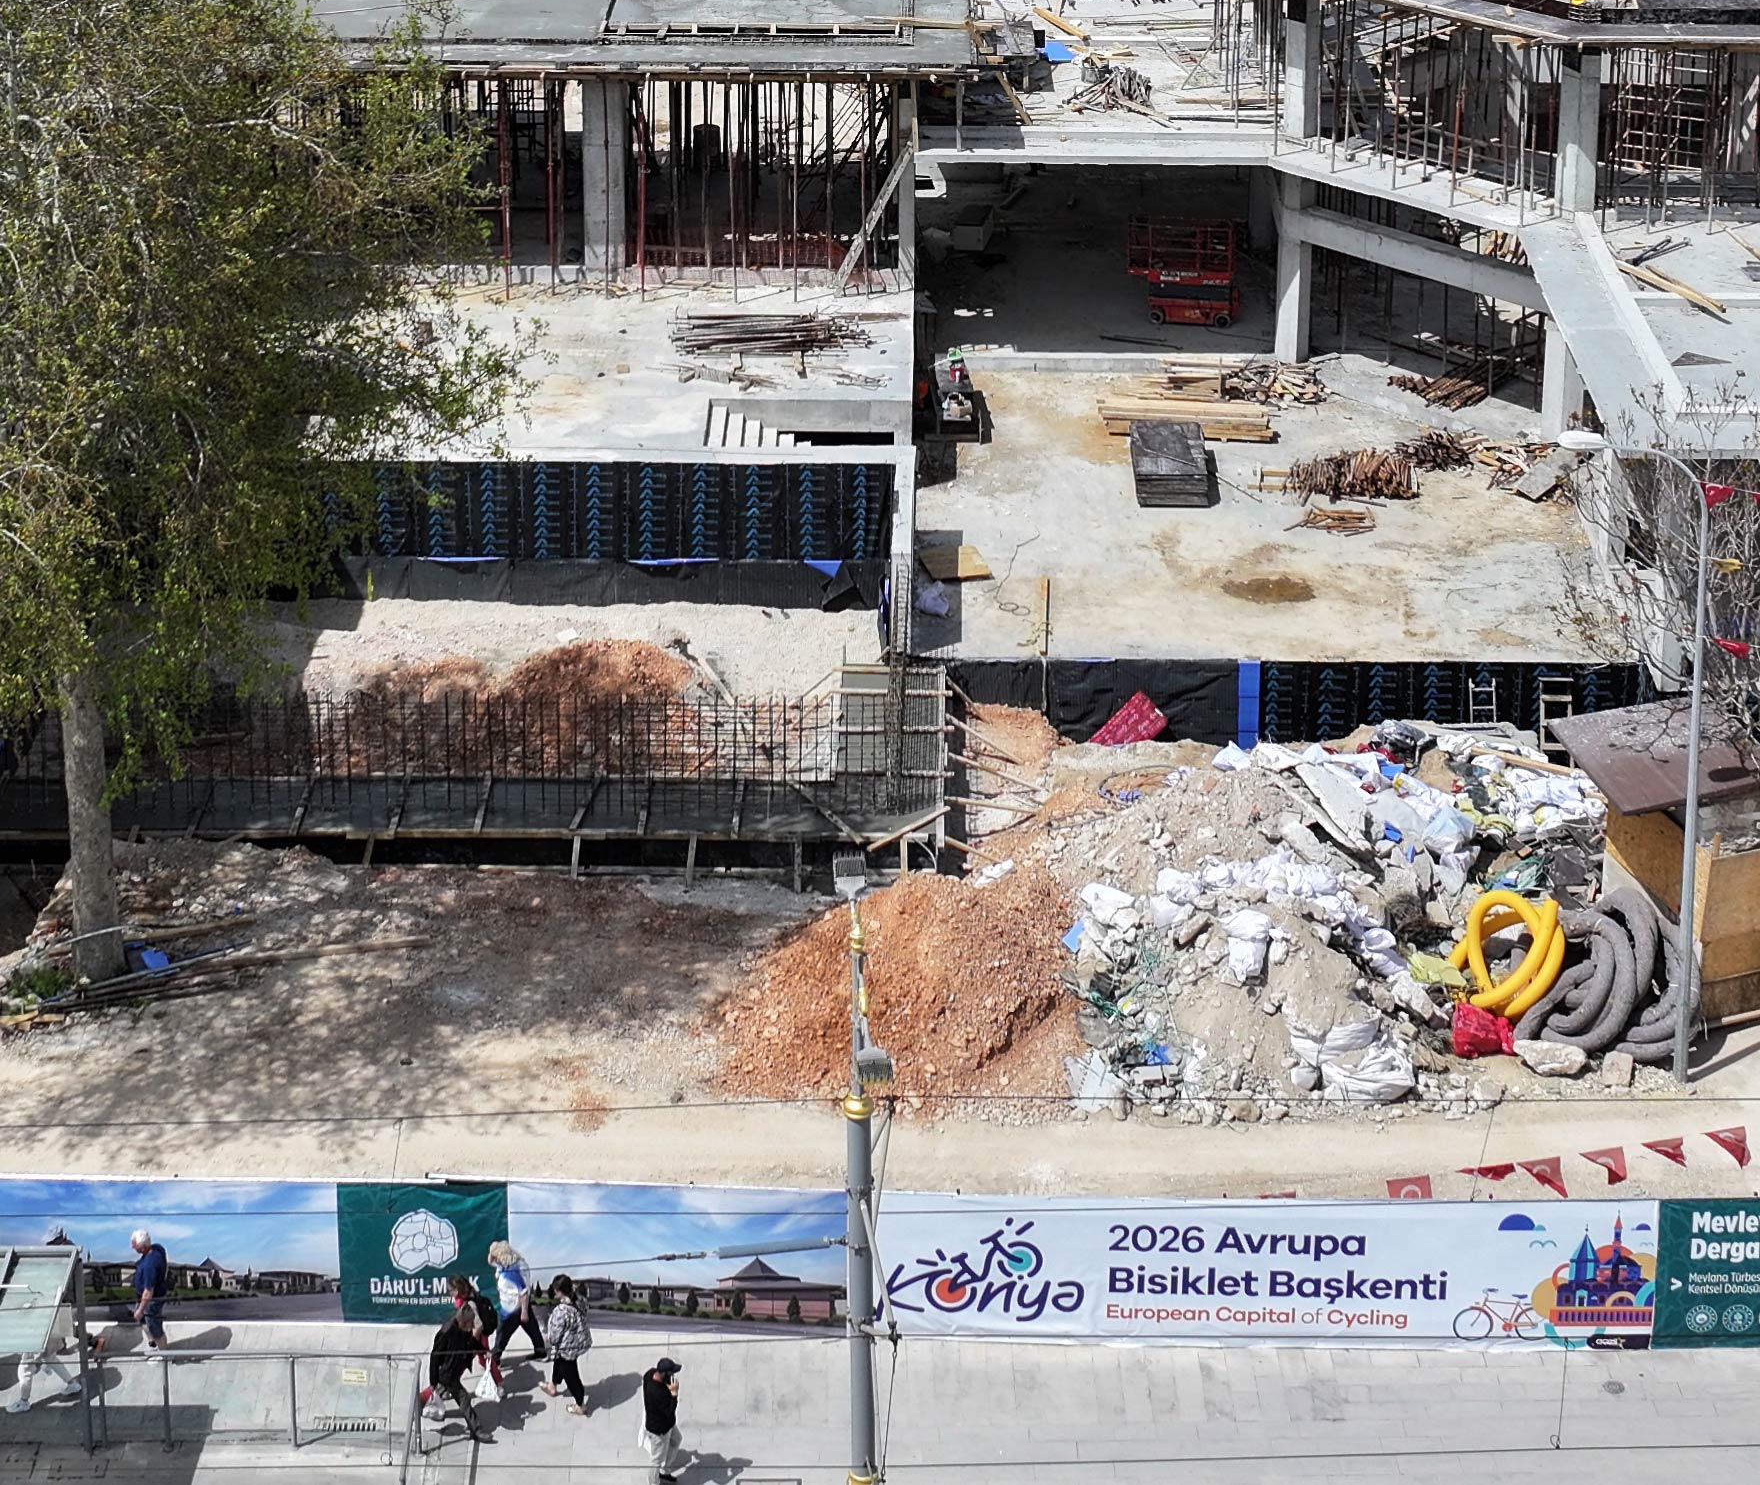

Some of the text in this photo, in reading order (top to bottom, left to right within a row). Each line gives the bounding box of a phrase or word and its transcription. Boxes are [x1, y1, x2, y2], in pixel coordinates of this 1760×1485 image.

[1108, 1224, 1367, 1262] 2026 Avrupa
[1108, 1264, 1449, 1305] Bisiklet Başkenti
[1688, 1283, 1723, 1294] Kentsel
[1689, 1272, 1729, 1283] Mevlana
[1106, 1303, 1409, 1330] European Capital of Cycling
